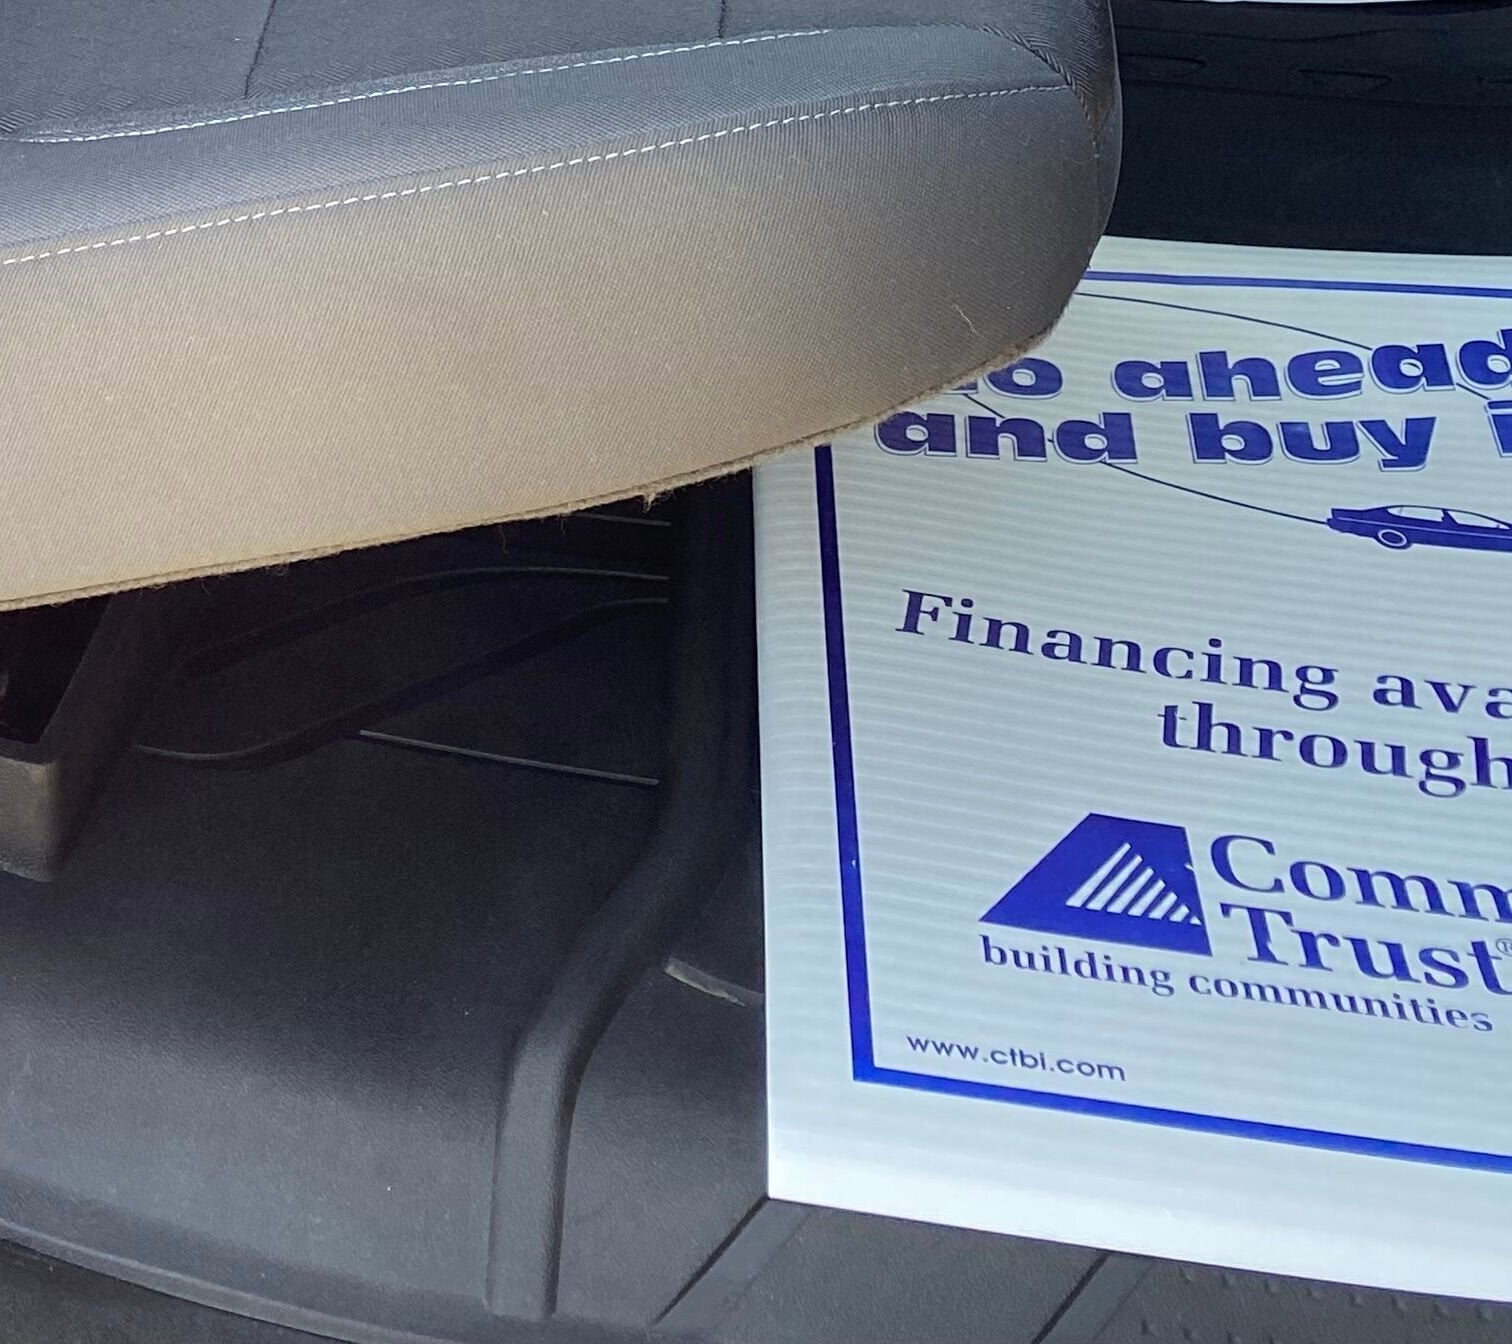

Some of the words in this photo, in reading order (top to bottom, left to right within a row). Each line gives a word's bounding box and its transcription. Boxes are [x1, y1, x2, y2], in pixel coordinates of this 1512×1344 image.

[951, 357, 1064, 400] o
[1112, 329, 1512, 400] ahead
[876, 412, 1138, 464] and
[1188, 412, 1436, 472] buy
[895, 589, 1339, 711] Financing
[1158, 701, 1512, 798] through
[979, 934, 1175, 997] building
[1188, 973, 1493, 1032] communities
[906, 1034, 1126, 1082] www.ctbi.com
